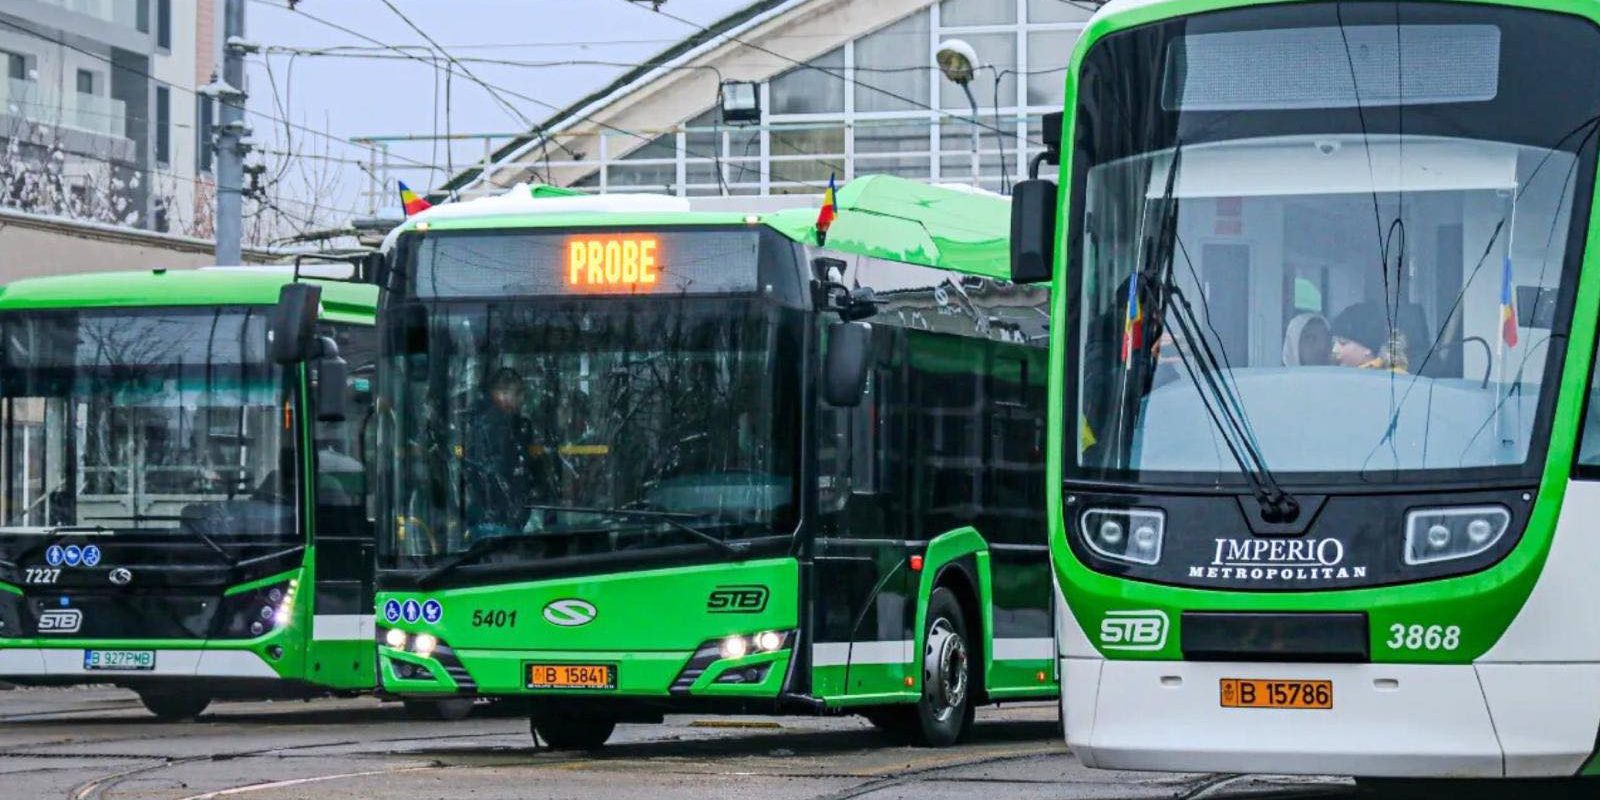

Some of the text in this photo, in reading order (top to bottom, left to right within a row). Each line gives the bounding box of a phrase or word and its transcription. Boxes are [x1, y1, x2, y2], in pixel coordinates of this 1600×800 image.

[569, 239, 657, 285] PROBE
[1211, 537, 1344, 567] IMPERIO
[25, 568, 61, 584] 7227
[1188, 566, 1367, 579] METROPOLITAN
[707, 589, 765, 610] STB
[38, 613, 78, 629] STB
[471, 608, 518, 628] 5401
[1100, 616, 1163, 644] STB
[1385, 623, 1462, 651] 3868
[92, 651, 151, 665] B 927PMB
[545, 667, 605, 684] B 15841
[1240, 682, 1329, 705] B 15786
